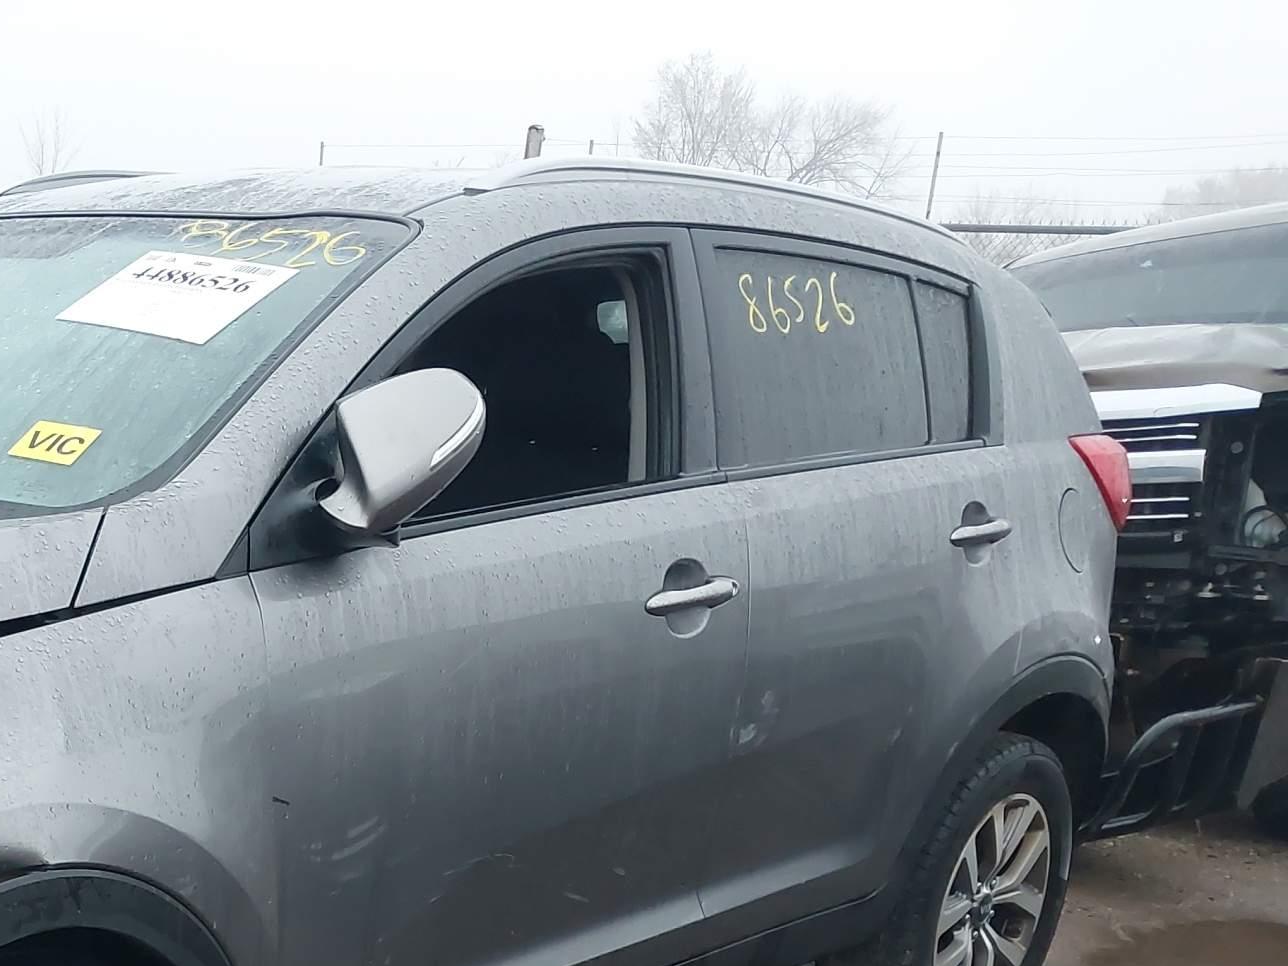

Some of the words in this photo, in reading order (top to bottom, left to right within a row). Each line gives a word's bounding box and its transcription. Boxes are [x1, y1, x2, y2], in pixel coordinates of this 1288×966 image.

[132, 266, 254, 294] 44886526
[739, 271, 855, 334] 86526
[28, 430, 86, 455] VIC
